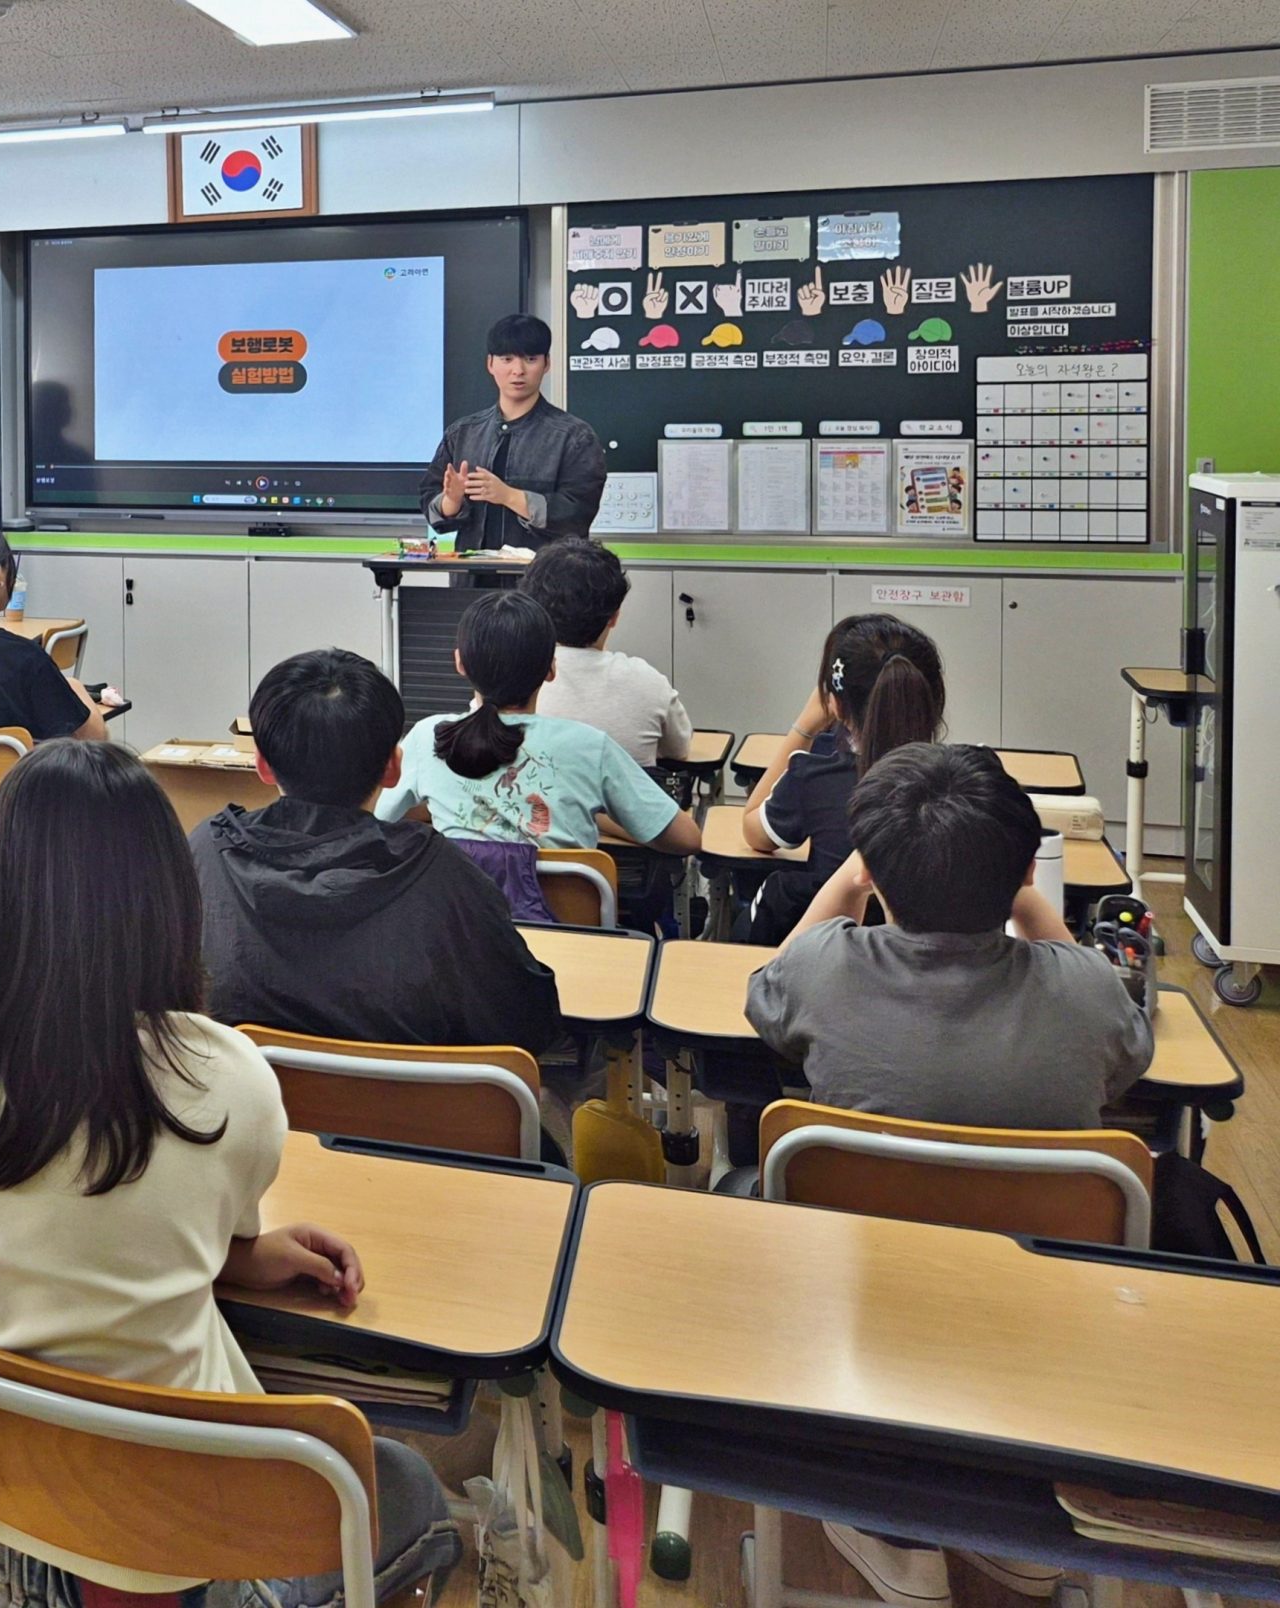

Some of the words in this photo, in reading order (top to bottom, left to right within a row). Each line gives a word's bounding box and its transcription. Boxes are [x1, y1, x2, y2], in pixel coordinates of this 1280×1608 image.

[747, 281, 788, 294] 기다려
[832, 284, 870, 302] 보충
[914, 281, 953, 300] 질문
[1009, 279, 1069, 297] 볼륨UP
[747, 295, 788, 309] 주세요
[1009, 307, 1039, 317] 발표를
[1041, 305, 1112, 317] 시작하겠습니다
[1009, 324, 1066, 336] 이상입니다
[231, 336, 294, 354] 보행로봇
[694, 354, 730, 367] 긍정적
[732, 354, 756, 367] 측면
[764, 353, 801, 365] 부정적
[803, 353, 828, 365] 측면
[915, 349, 952, 360] 창의적
[571, 357, 606, 369] 객관적
[909, 360, 957, 372] 아이디어
[231, 367, 294, 384] 실험방법
[1016, 363, 1048, 377] 오늘의
[876, 588, 922, 600] 안전장구
[929, 590, 965, 603] 보관함
